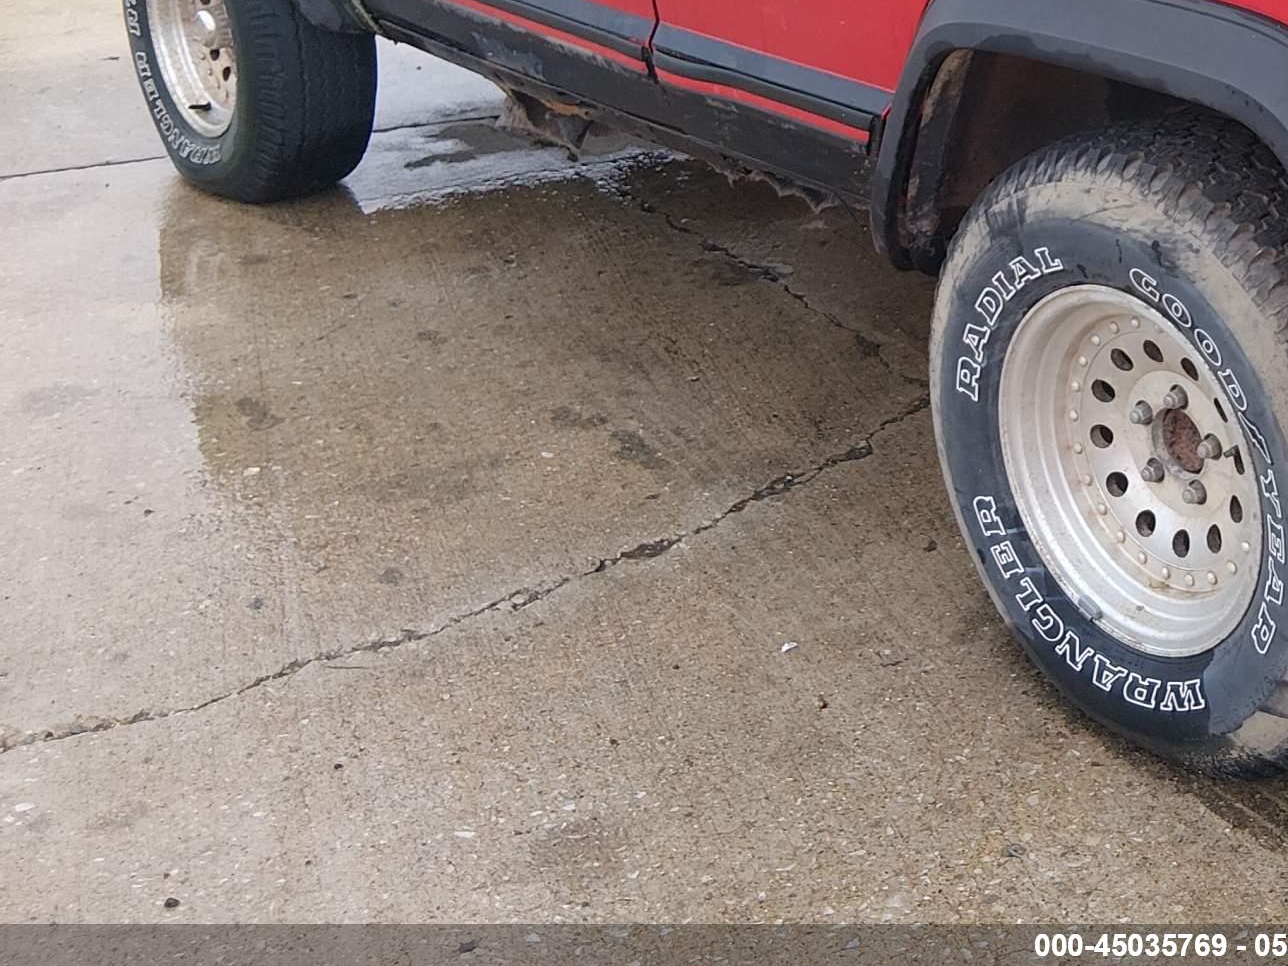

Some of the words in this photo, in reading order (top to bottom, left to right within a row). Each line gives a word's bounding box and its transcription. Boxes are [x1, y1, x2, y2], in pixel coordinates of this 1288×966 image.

[135, 51, 222, 165] WRANGLER
[956, 247, 1063, 402] RADIAL
[1128, 266, 1288, 655] GOODYEAR
[972, 494, 1207, 713] WRANGLER
